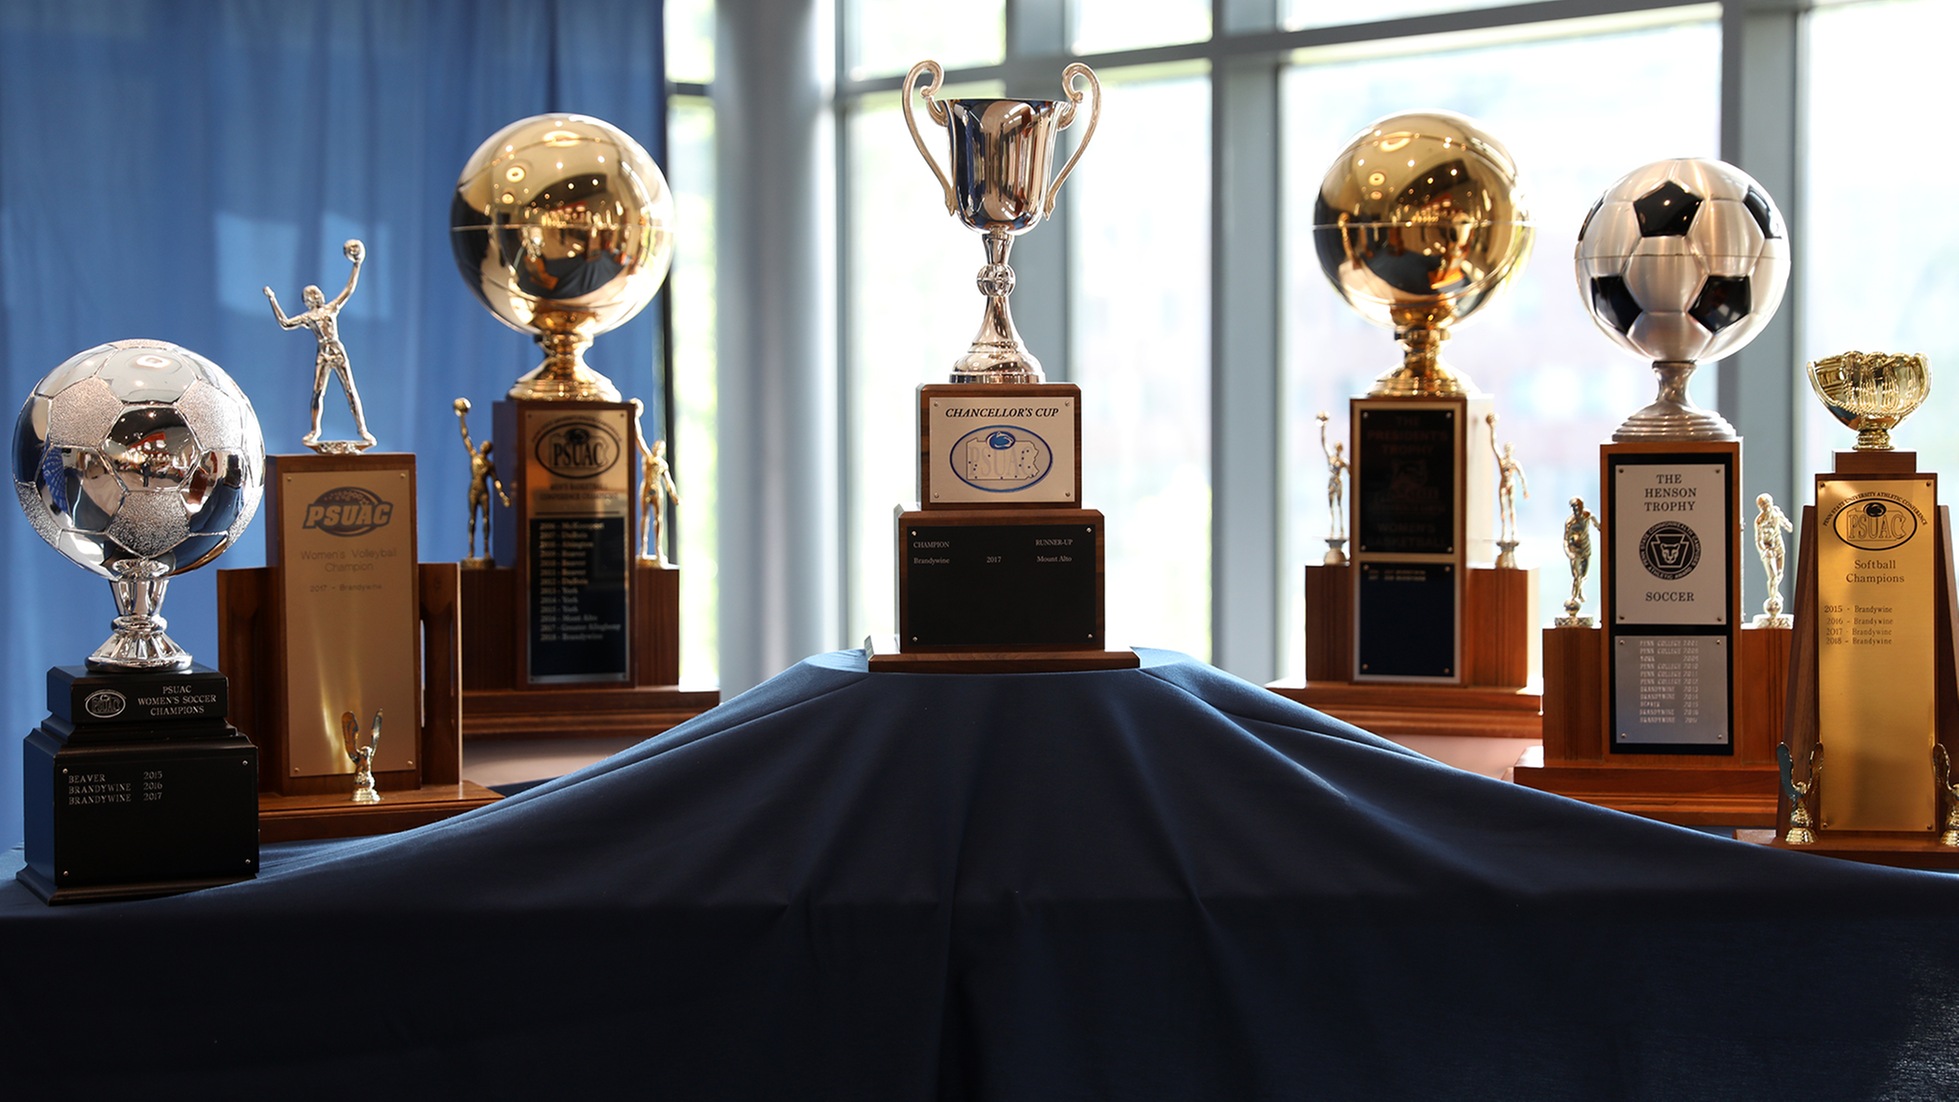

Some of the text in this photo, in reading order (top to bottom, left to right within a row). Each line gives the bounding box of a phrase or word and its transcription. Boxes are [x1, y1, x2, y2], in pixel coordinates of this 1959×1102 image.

[945, 407, 1059, 417] CHANCELLOR'S CUP
[1656, 474, 1682, 484] THE
[1644, 488, 1697, 498] HENSON
[1644, 501, 1696, 512] TROPHY
[304, 502, 393, 528] PSUAC
[1849, 514, 1905, 539] PSUAC
[301, 548, 397, 560] Women's Volleyball
[913, 557, 950, 566] Brandywine
[1058, 555, 1073, 563] Alto
[1854, 559, 1896, 570] Softball
[324, 562, 374, 573] Champion
[1845, 573, 1905, 584] Champions
[1645, 591, 1695, 602] SOCCER
[1824, 605, 1843, 613] 2015
[1854, 605, 1893, 614] Brandywine
[1826, 617, 1844, 625] 2016
[1854, 617, 1894, 626] Brandywine
[1852, 628, 1892, 636] Brandywine
[1825, 637, 1842, 645] 2018
[1852, 637, 1892, 646] Brandywine
[162, 685, 192, 695] PSUAC
[137, 695, 181, 706] WOMEN'S
[182, 694, 217, 704] SOCCER
[150, 705, 205, 716] CHAMPIONS
[68, 771, 163, 784] BEAVER 2015
[68, 782, 163, 795] BRANDYWINE 2016
[68, 792, 163, 806] BRANDYWINE 2017
